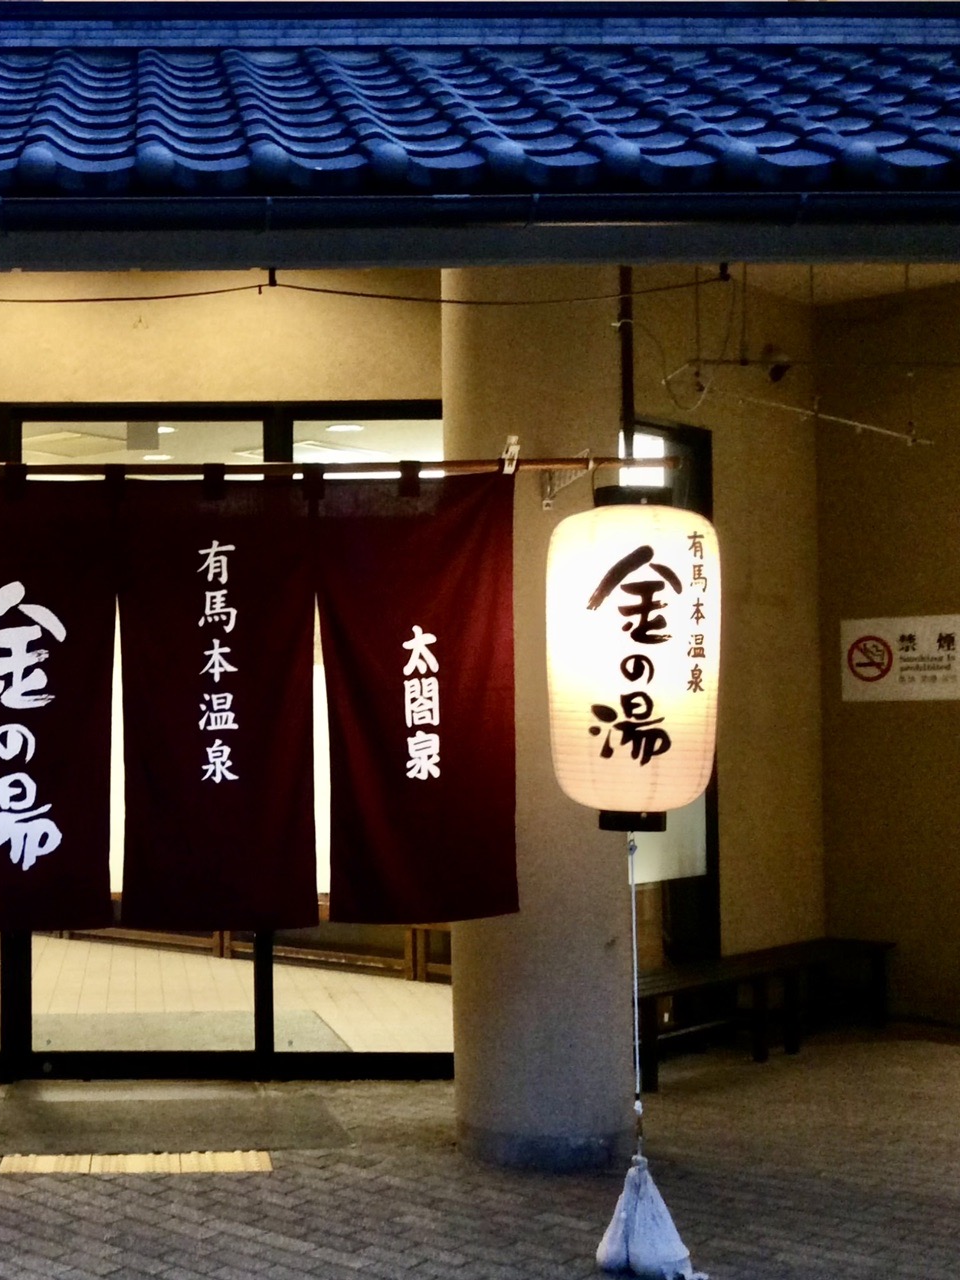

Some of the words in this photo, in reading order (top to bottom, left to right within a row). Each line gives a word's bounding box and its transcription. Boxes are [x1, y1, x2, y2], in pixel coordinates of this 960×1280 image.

[197, 540, 240, 783] 有馬本温泉
[402, 625, 441, 781] 太閤泉
[587, 545, 683, 766] 金の湯
[687, 531, 708, 693] 有馬本温泉
